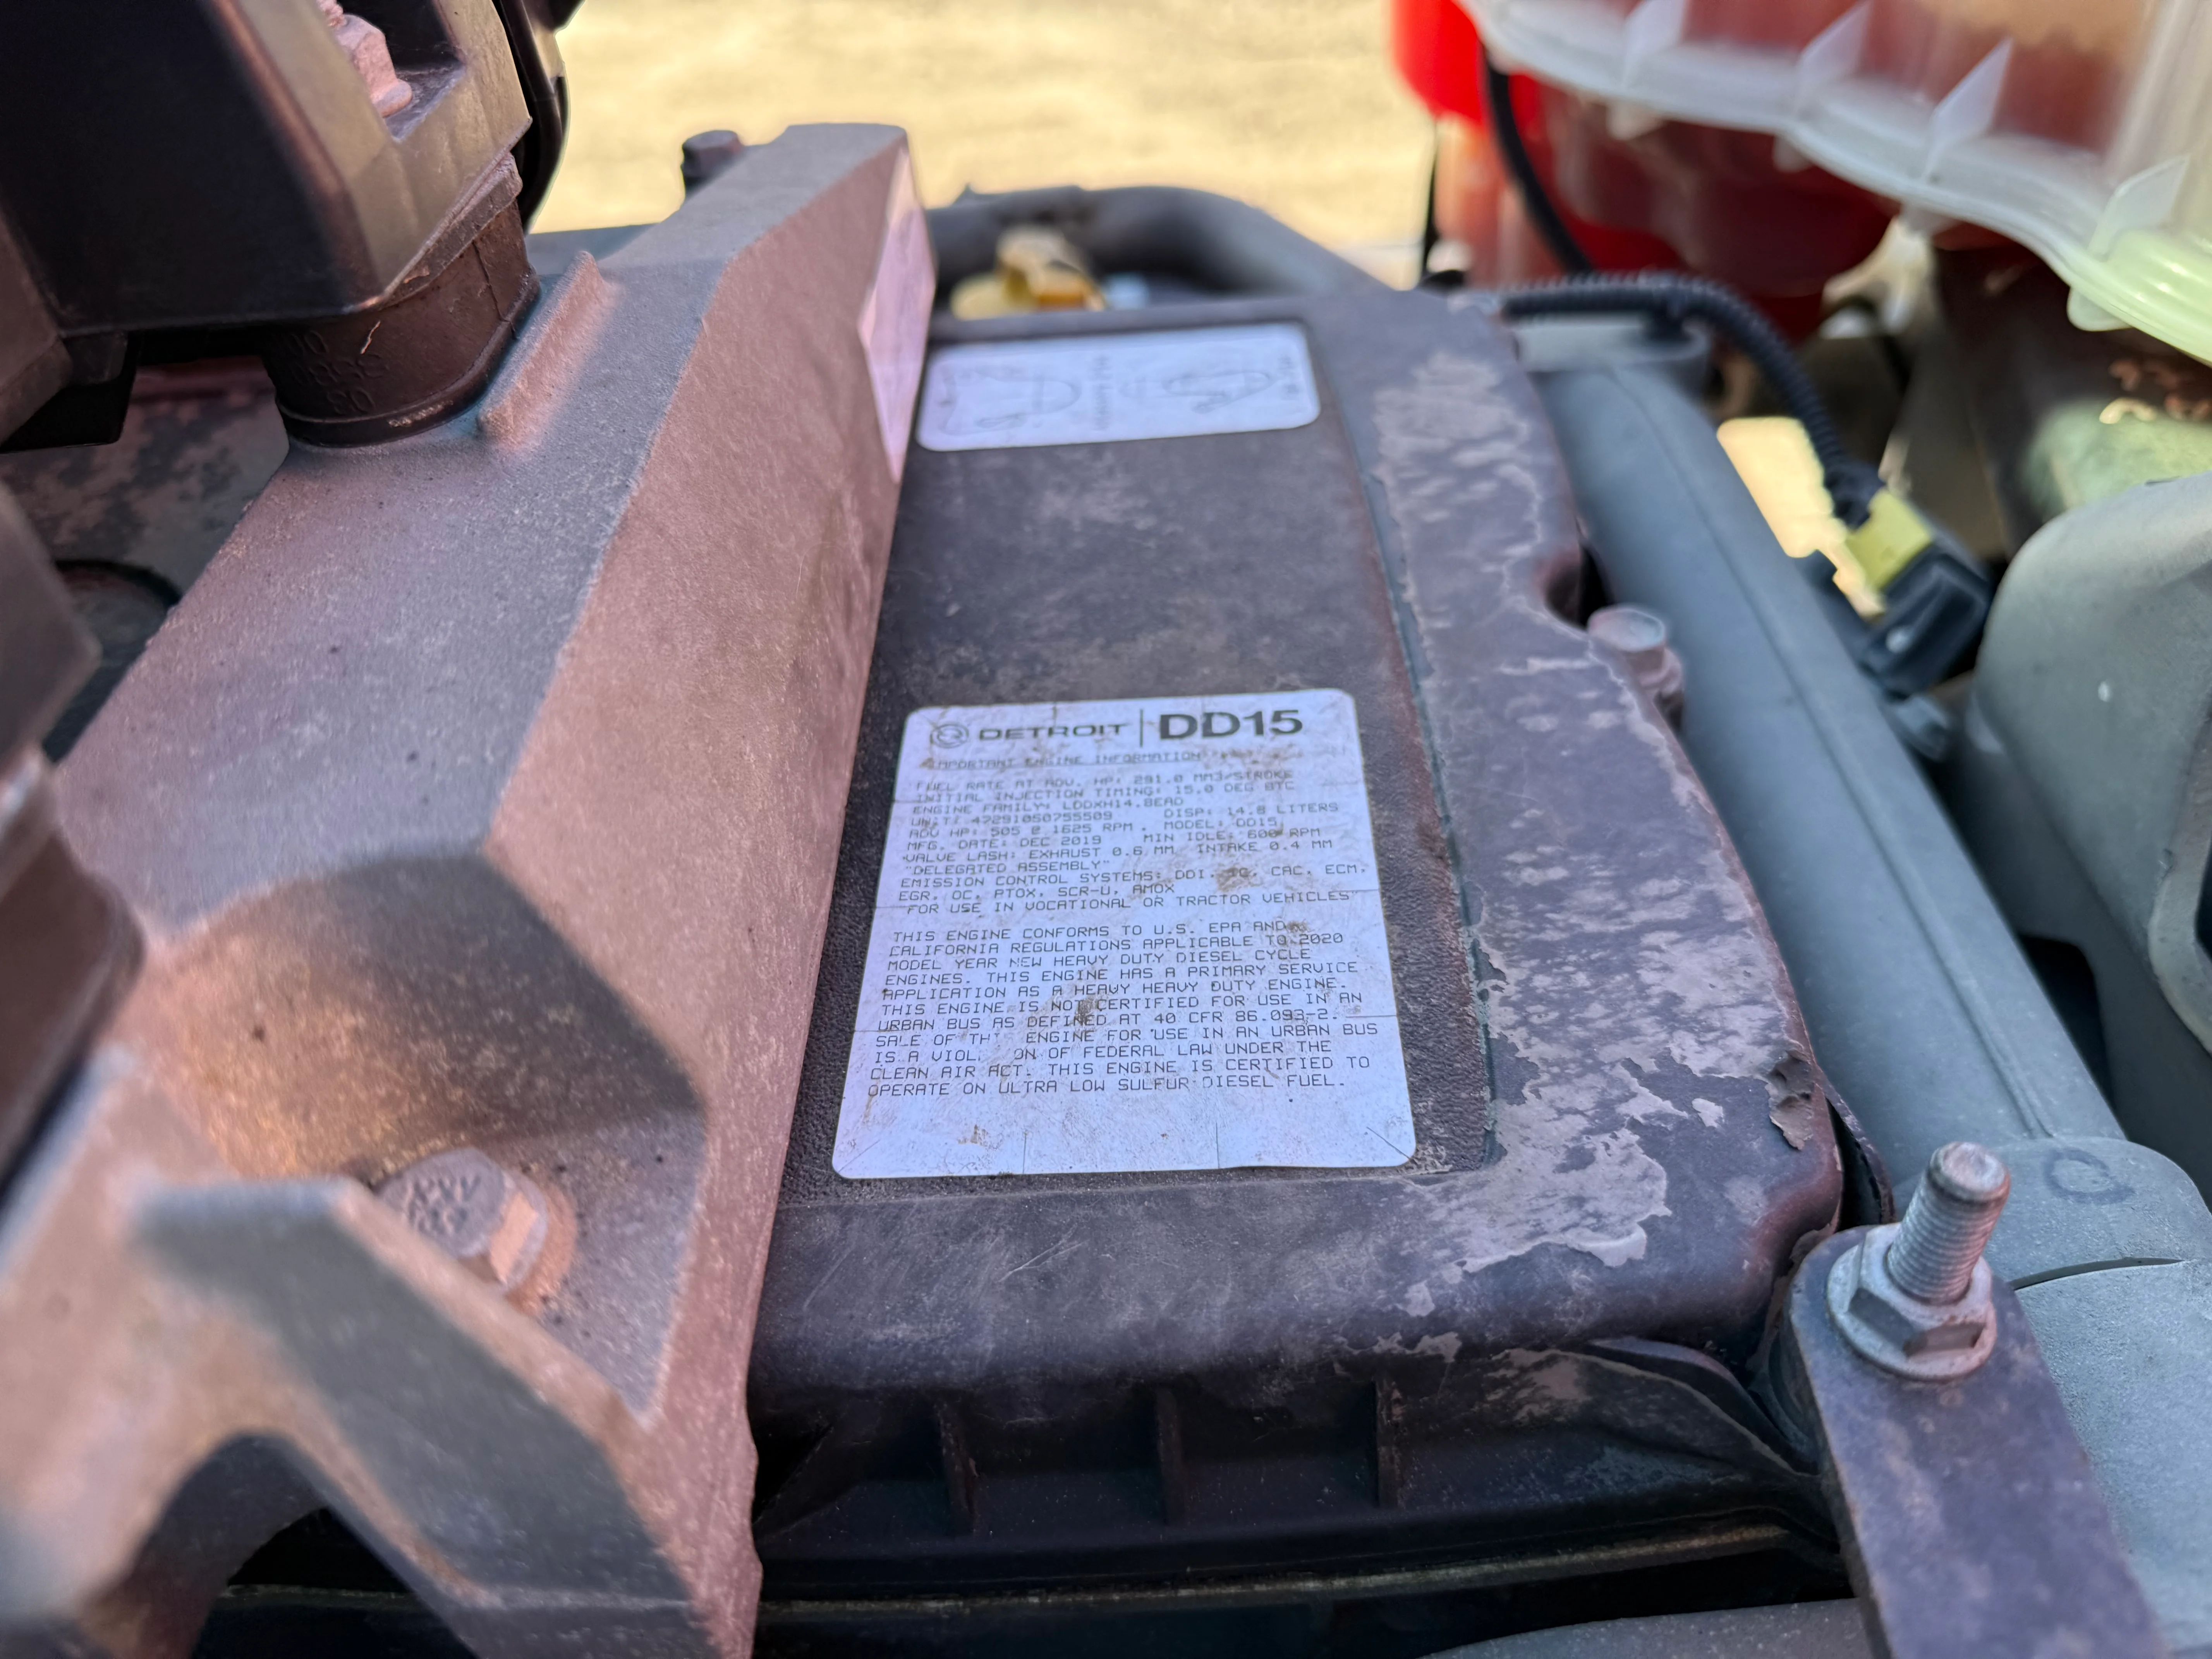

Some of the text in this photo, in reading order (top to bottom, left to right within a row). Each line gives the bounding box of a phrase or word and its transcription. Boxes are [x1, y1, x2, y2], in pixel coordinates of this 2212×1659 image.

[979, 709, 1303, 740] DETROIT DD15
[929, 758, 1014, 768] MPORTANT
[1096, 751, 1200, 764] INFORMATION
[915, 781, 1295, 802] INITIAL INJECTION TIMING: 15.0 DEG BTC
[917, 782, 955, 791] FUEL
[967, 781, 1005, 790] RATE
[1016, 780, 1032, 788] AT
[1094, 778, 1121, 786] HP:
[914, 804, 969, 814] ENGINE
[1164, 808, 1212, 819] DISP:
[1228, 805, 1265, 816] 14.8
[1277, 802, 1338, 813] LITERS
[910, 829, 939, 838] ADV
[950, 828, 977, 837] HP:
[991, 826, 1020, 836] 505
[1032, 825, 1040, 835] @
[1053, 823, 1091, 834] 1625
[1164, 819, 1223, 830] MODEL:
[1236, 816, 1277, 827] DD15
[959, 838, 1006, 849] DATE:
[1020, 837, 1050, 847] DEC
[1061, 835, 1101, 846] 2019
[1144, 833, 1173, 843] MIN
[1188, 831, 1233, 841] IDLE:
[1248, 829, 1278, 839] 600
[1290, 828, 1320, 838] RPM
[906, 840, 1332, 863] VALVE LASH: EXHAUST 0.6 MM INTAKE 0.4 MM
[901, 878, 984, 888] EMISSION
[996, 874, 1068, 886] CONTROL
[1080, 871, 1161, 883] SYSTEMS:
[1271, 866, 1311, 876] CAC,
[1325, 864, 1365, 874] ECM,
[906, 860, 1109, 875] "DELEGATED ASSEMBLY"
[950, 903, 981, 913] USE
[995, 902, 1013, 912] IN
[1025, 898, 1130, 911] VOCATIONAL
[1144, 897, 1163, 907] OR
[1176, 894, 1250, 906] TRACTOR
[1262, 891, 1357, 903] VEHICLES"
[952, 890, 980, 900] OC,
[994, 888, 1043, 898] PTOX,
[1058, 886, 1118, 897] SCR-U,
[1133, 884, 1174, 895] AMOX
[894, 921, 1286, 942] THIS ENGINE CONFORMS TO U.S. EPA AND
[890, 933, 1343, 957] CALIFORNIA REGULATIONS APPLICABLE TO 2020
[888, 948, 1310, 971] MODEL YEAR NEW HEAVY DUTY DIESEL CYCLE
[886, 962, 1358, 985] ENGINES. THIS ENGINE HAS A PRIMARY SERVICE
[883, 977, 1346, 1001] APPLICATION AS A HEAVY HEAVY DUTY ENGINE.
[882, 992, 1362, 1015] THIS ENGINE IS NOT CERTIFIED FOR USE IN AN
[879, 1008, 1338, 1031] URBAN BUS AS DEFINED AT 40 CFR 86.093-2.
[876, 1034, 922, 1047] SALE
[934, 1034, 955, 1046] OF
[1027, 1030, 1094, 1043] ENGINE
[1108, 1029, 1141, 1041] FOR
[1153, 1028, 1187, 1040] USE
[1203, 1027, 1223, 1039] IN
[1236, 1026, 1258, 1038] AN
[1271, 1024, 1330, 1037] URBAN
[1343, 1023, 1378, 1035] BUS
[876, 1040, 1331, 1063] IS A VIOLON OF FEDERAL LAW UNDER THE
[871, 1056, 1370, 1080] CLEAN AIR ACT. THIS ENGINE IS CERTIFIED TO
[868, 1073, 1345, 1097] OPERATE ON ULTRA LOW SULFUR DIESEL FUEL.
